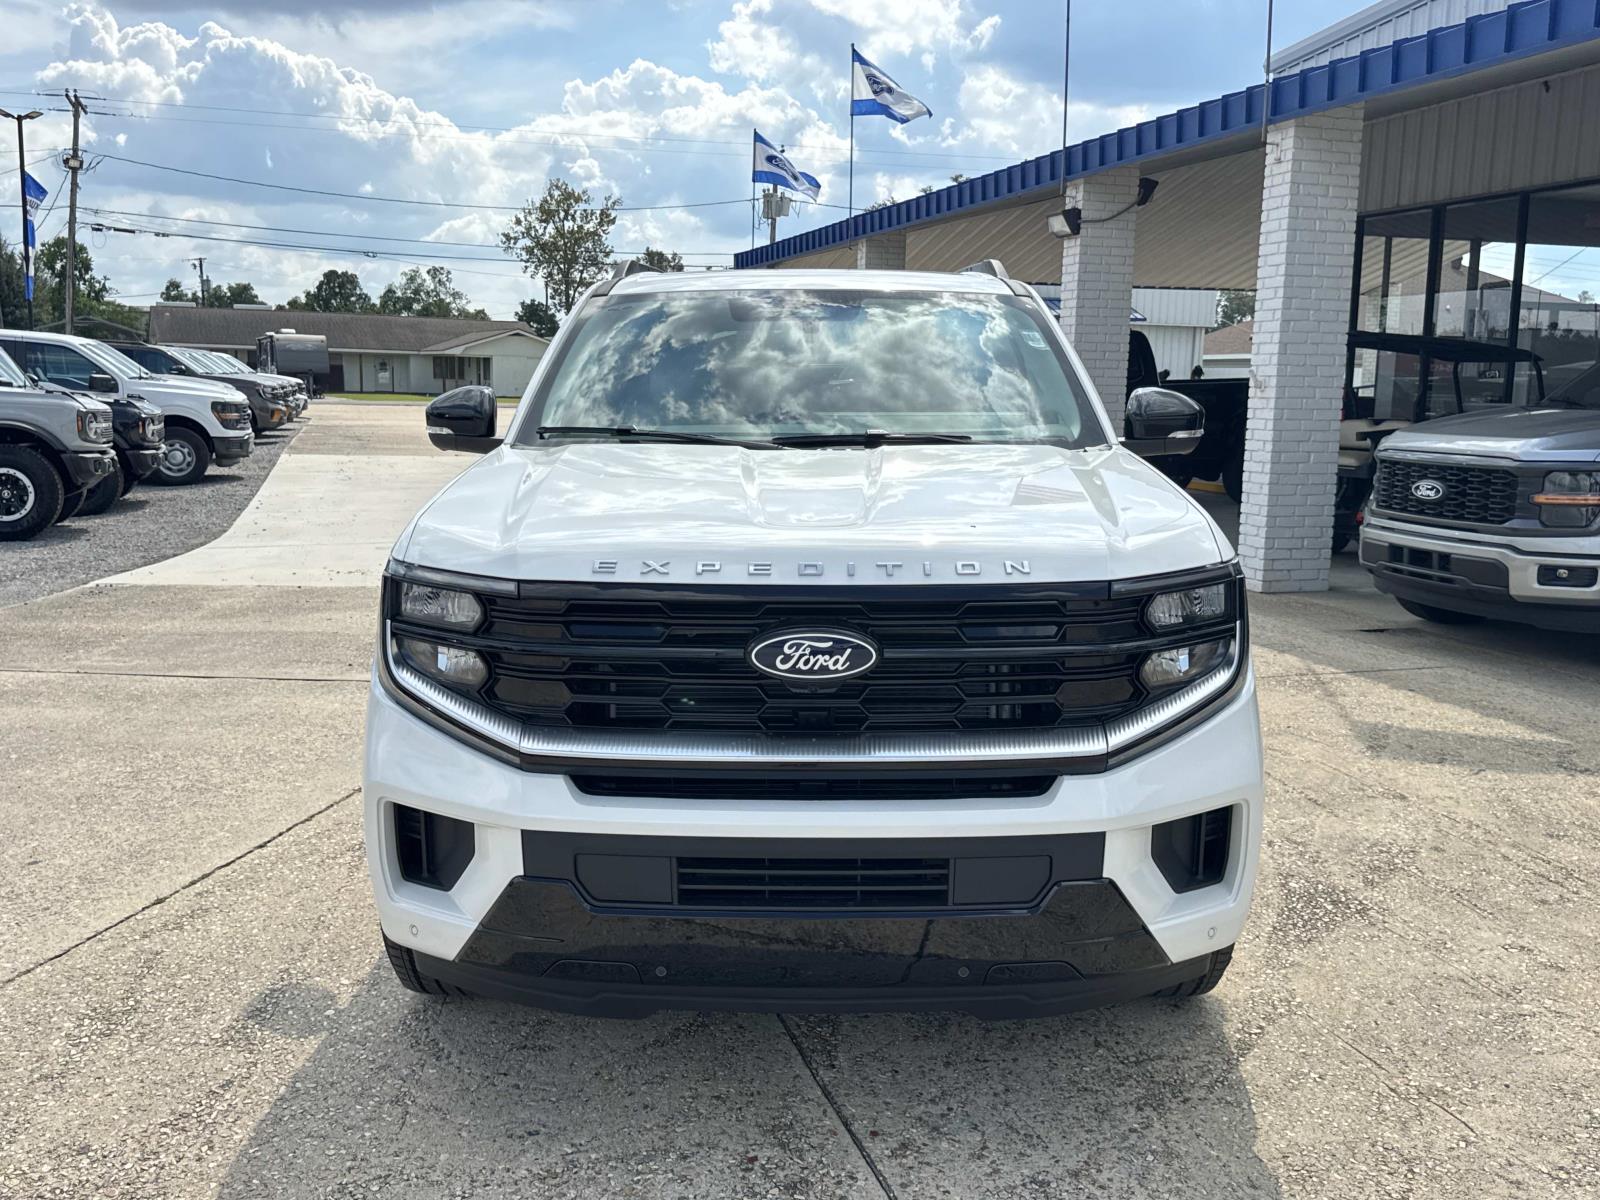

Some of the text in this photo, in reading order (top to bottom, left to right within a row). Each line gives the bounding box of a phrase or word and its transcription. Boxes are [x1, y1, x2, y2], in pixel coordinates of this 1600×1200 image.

[1417, 484, 1436, 496] Ford
[592, 559, 1031, 576] EXPEDITION
[775, 639, 852, 671] Ford
